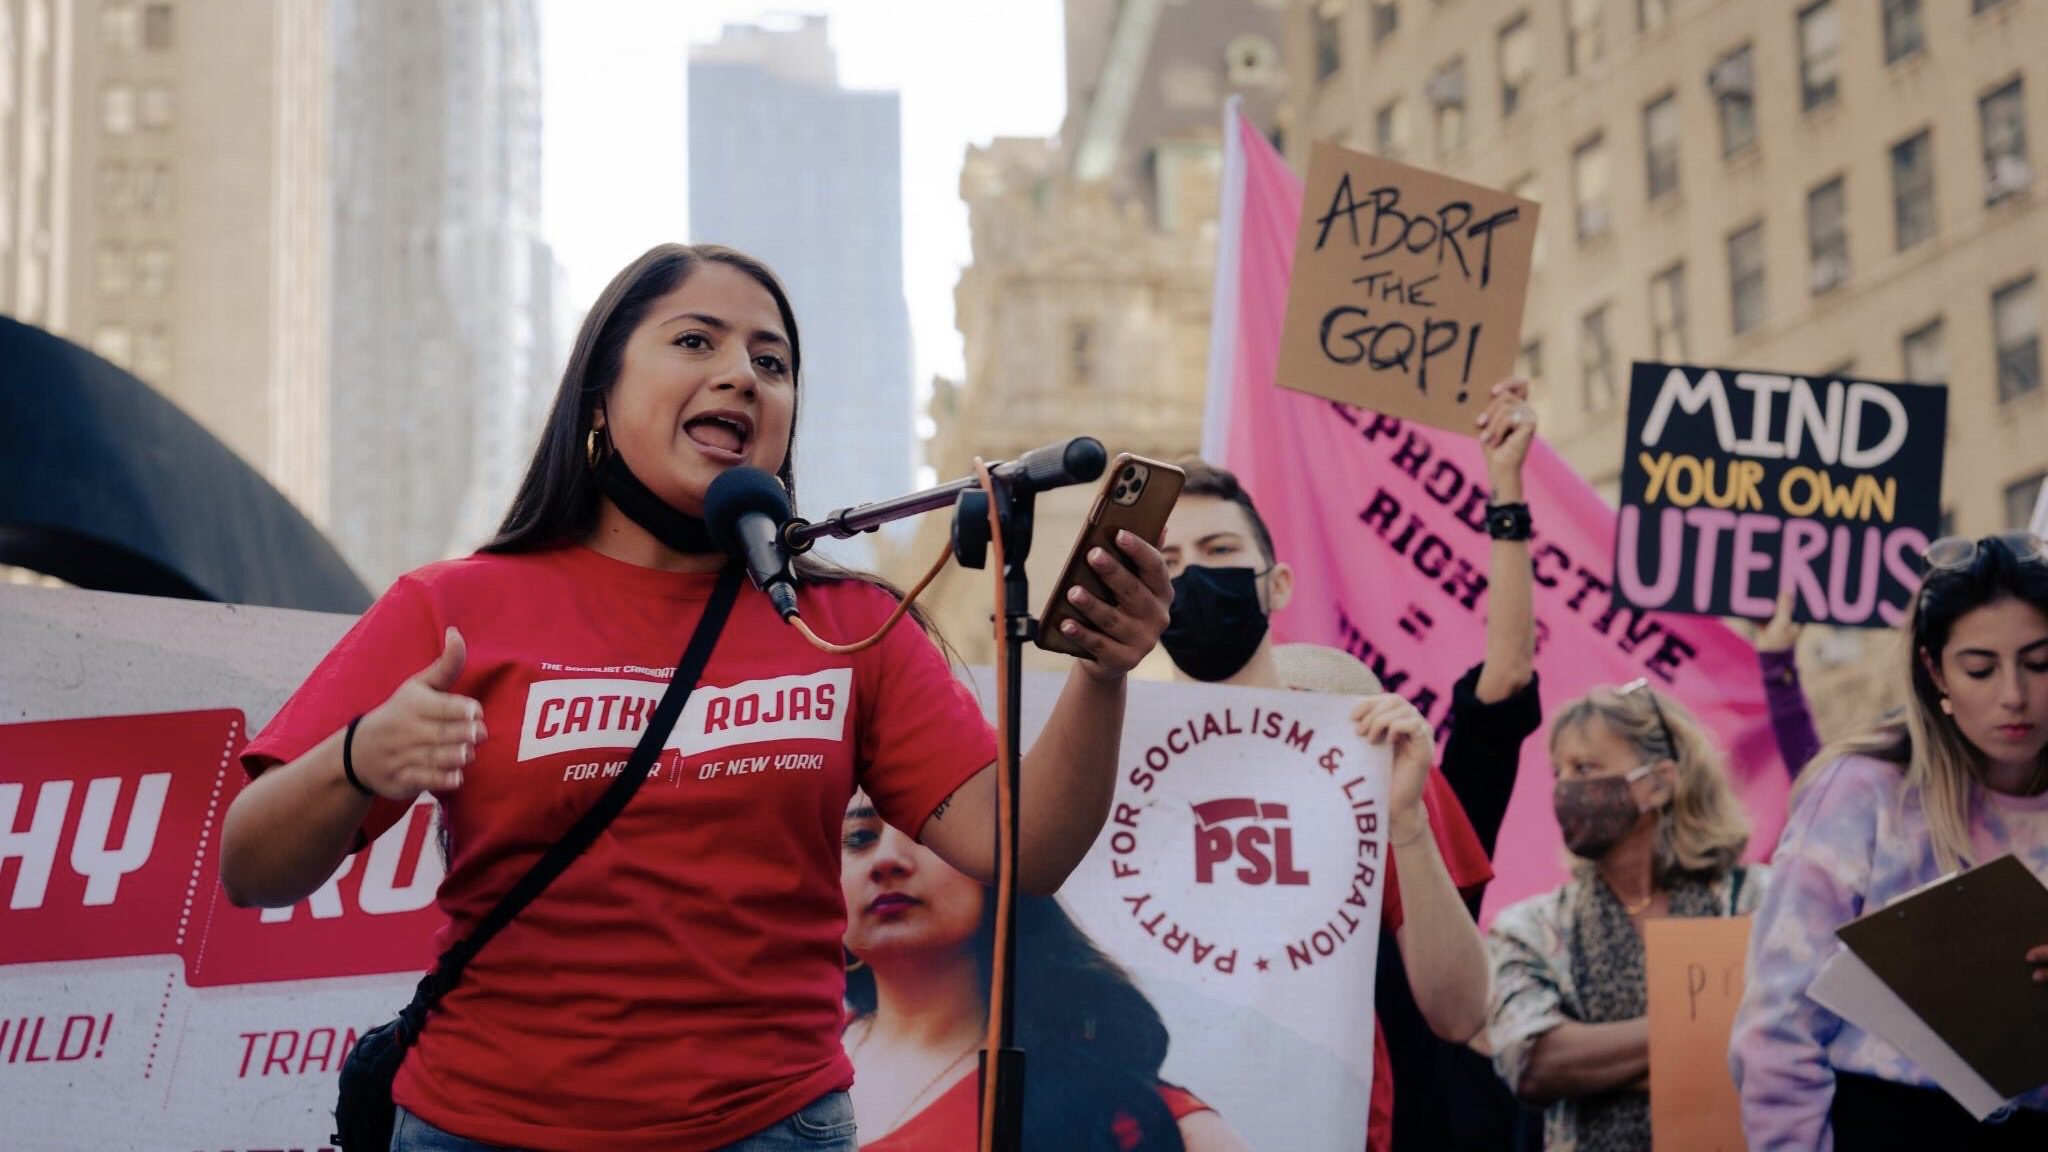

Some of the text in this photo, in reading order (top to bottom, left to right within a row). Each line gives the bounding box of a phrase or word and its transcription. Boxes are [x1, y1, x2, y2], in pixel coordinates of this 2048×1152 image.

[1315, 171, 1519, 290] ABORT
[1352, 271, 1439, 307] THE
[1320, 306, 1482, 404] GQP!
[1640, 368, 1909, 469] MIND
[1638, 452, 1897, 523] YOUR OWN
[1616, 504, 1933, 628] UTERUS
[541, 662, 563, 671] THE
[623, 665, 678, 678] CANDIDAT
[704, 683, 836, 734] ROJAS
[563, 762, 600, 782] FOR
[698, 762, 724, 780] OF
[726, 757, 769, 776] NEW
[773, 755, 824, 771] YORK!
[1110, 707, 1378, 974] PARTY FOR SOCIALISM & LIBERATION
[1194, 823, 1310, 886] PSL
